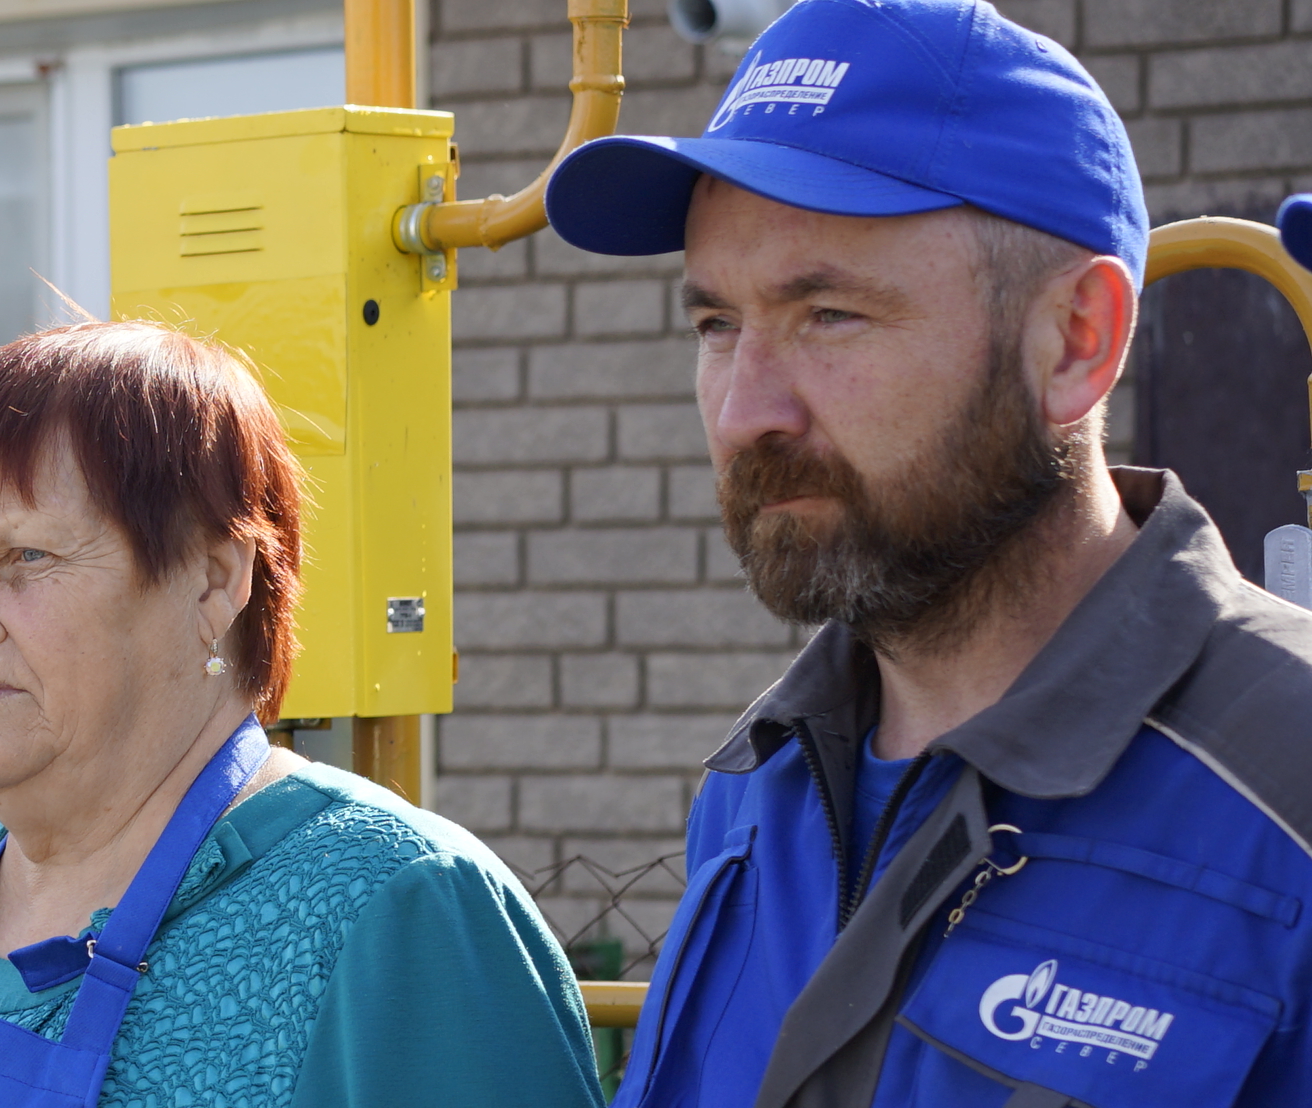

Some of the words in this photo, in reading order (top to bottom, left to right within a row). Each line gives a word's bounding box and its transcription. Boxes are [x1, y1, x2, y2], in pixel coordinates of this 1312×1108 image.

[745, 58, 850, 91] ГАЗПРОМ
[1045, 983, 1175, 1041] ГАЗПРОМ
[1029, 1035, 1148, 1073] СЕВЕР
[1041, 1021, 1151, 1054] ГАЗОРАСПРЕДЕЛЕНИЕ
